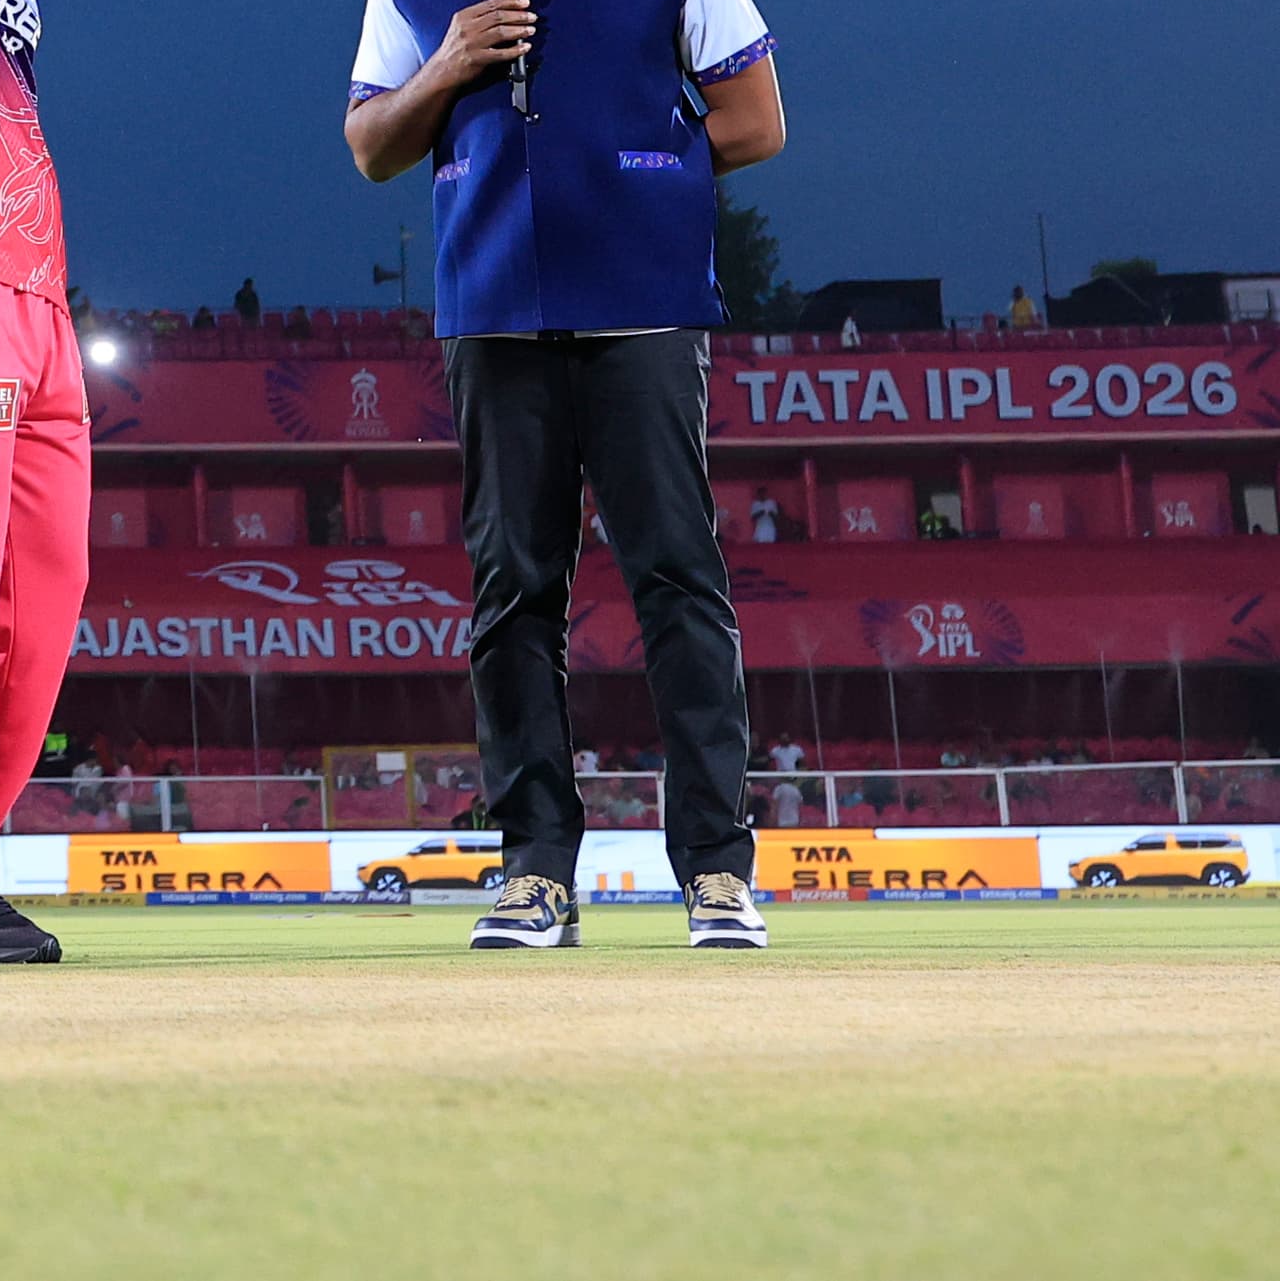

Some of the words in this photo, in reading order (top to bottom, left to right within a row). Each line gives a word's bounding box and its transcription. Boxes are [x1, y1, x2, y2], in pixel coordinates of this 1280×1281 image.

[735, 369, 909, 422] TATA
[926, 367, 1033, 420] IPL
[1048, 361, 1238, 418] 2026
[324, 590, 474, 607] IPL
[937, 632, 982, 658] IPL
[101, 851, 157, 865] TATA
[792, 847, 851, 862] TATA
[101, 873, 282, 891] SIERRA
[792, 870, 989, 889] SIERRA
